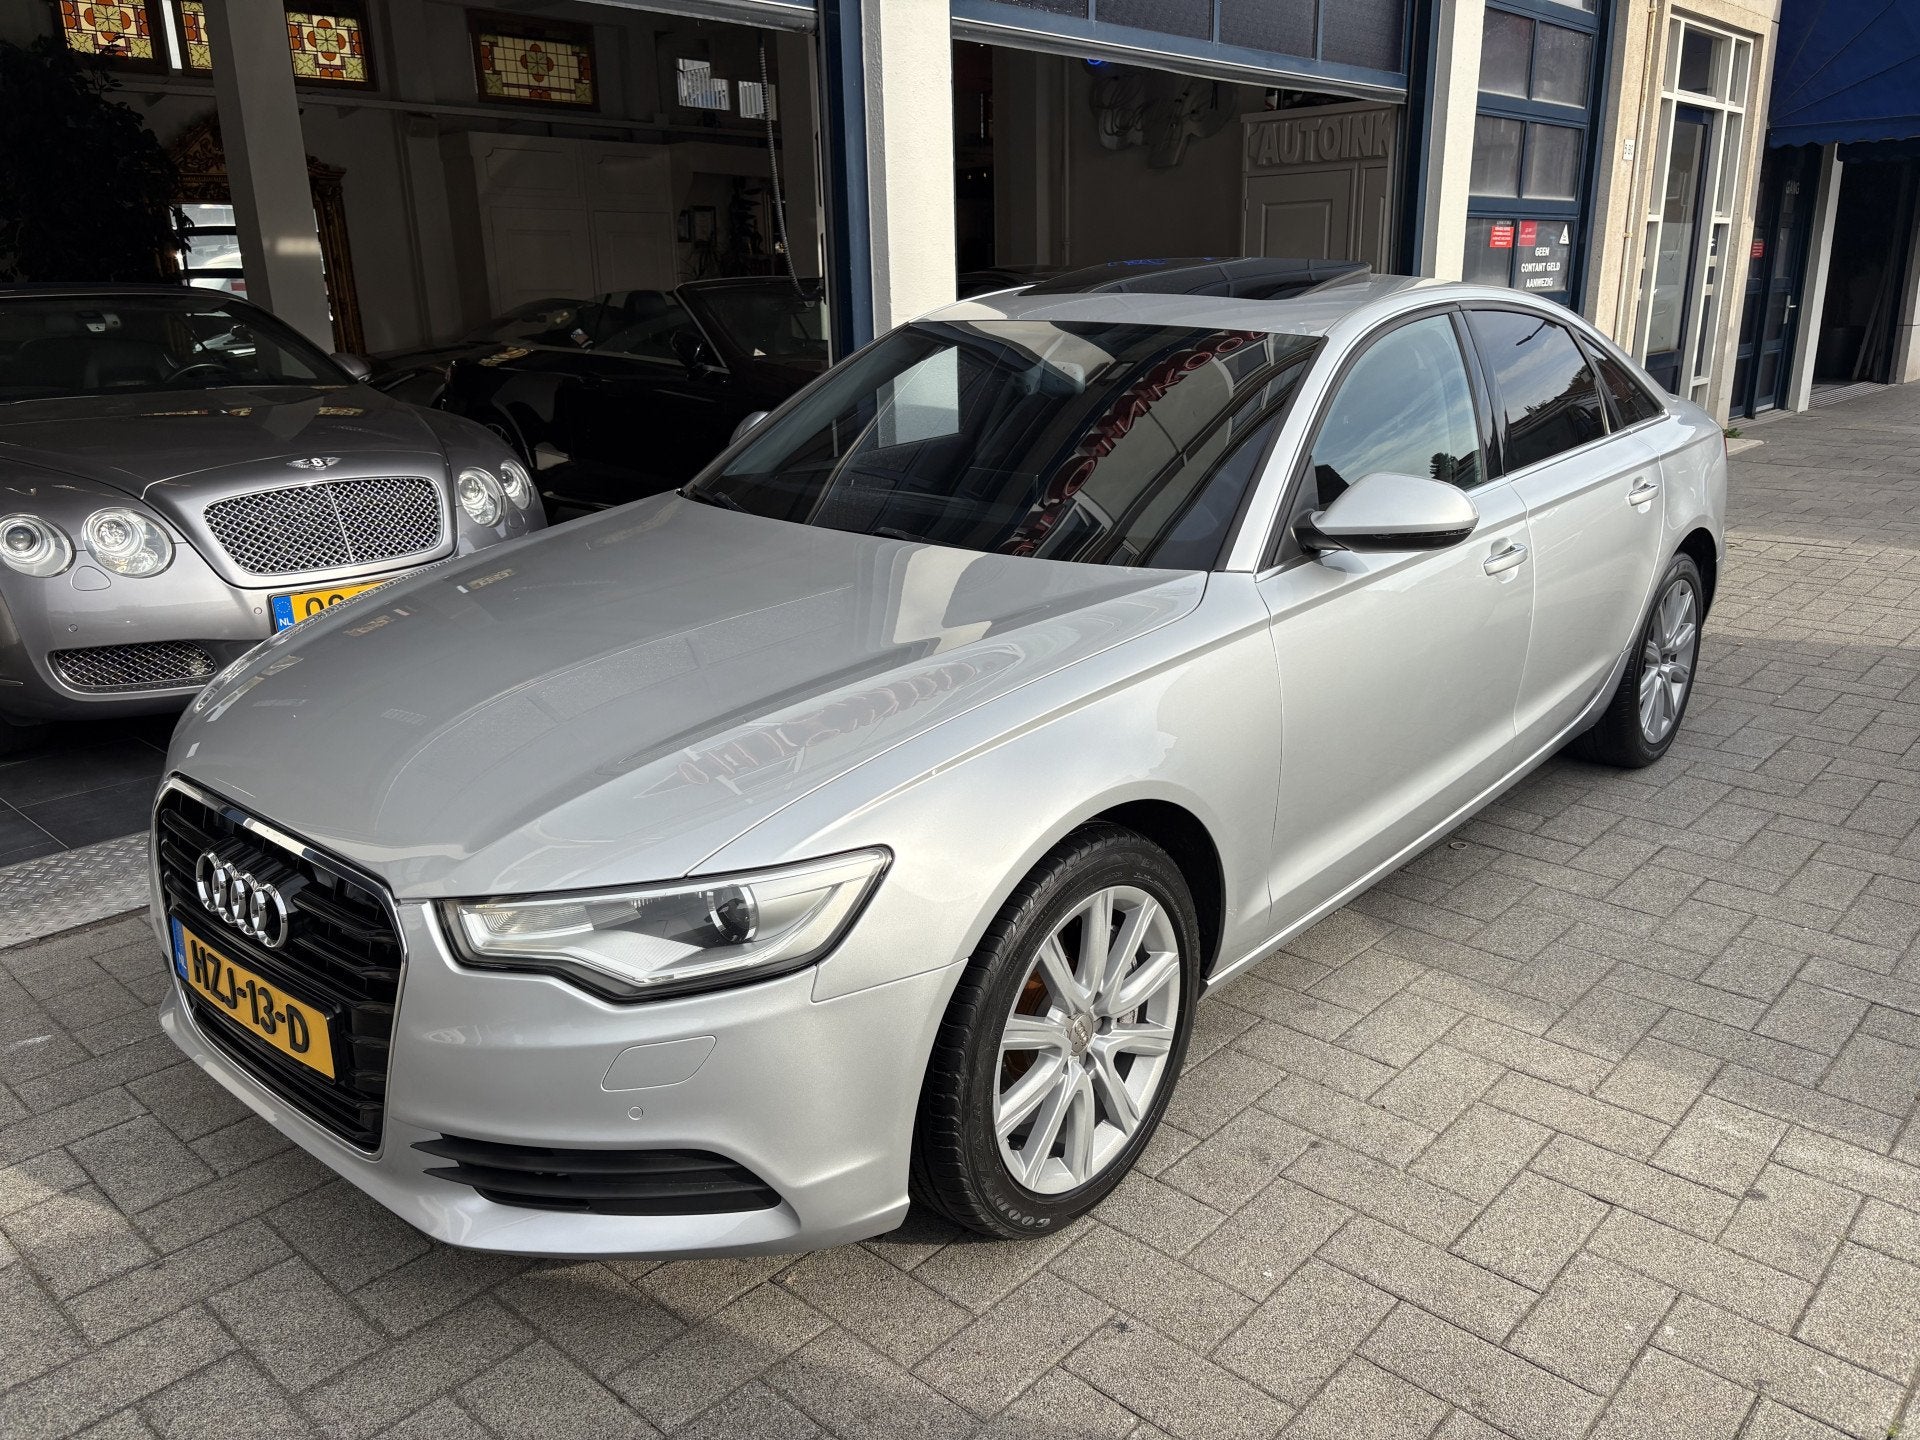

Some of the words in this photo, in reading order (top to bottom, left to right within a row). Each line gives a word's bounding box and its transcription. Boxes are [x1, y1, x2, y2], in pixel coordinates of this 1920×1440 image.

[1534, 247, 1550, 257] GEEN
[1521, 262, 1546, 273] CONTANT
[1546, 262, 1561, 272] GELD
[1525, 278, 1553, 288] AANWEZIG
[279, 618, 293, 627] NL
[190, 939, 310, 1054] HZJ-13-D
